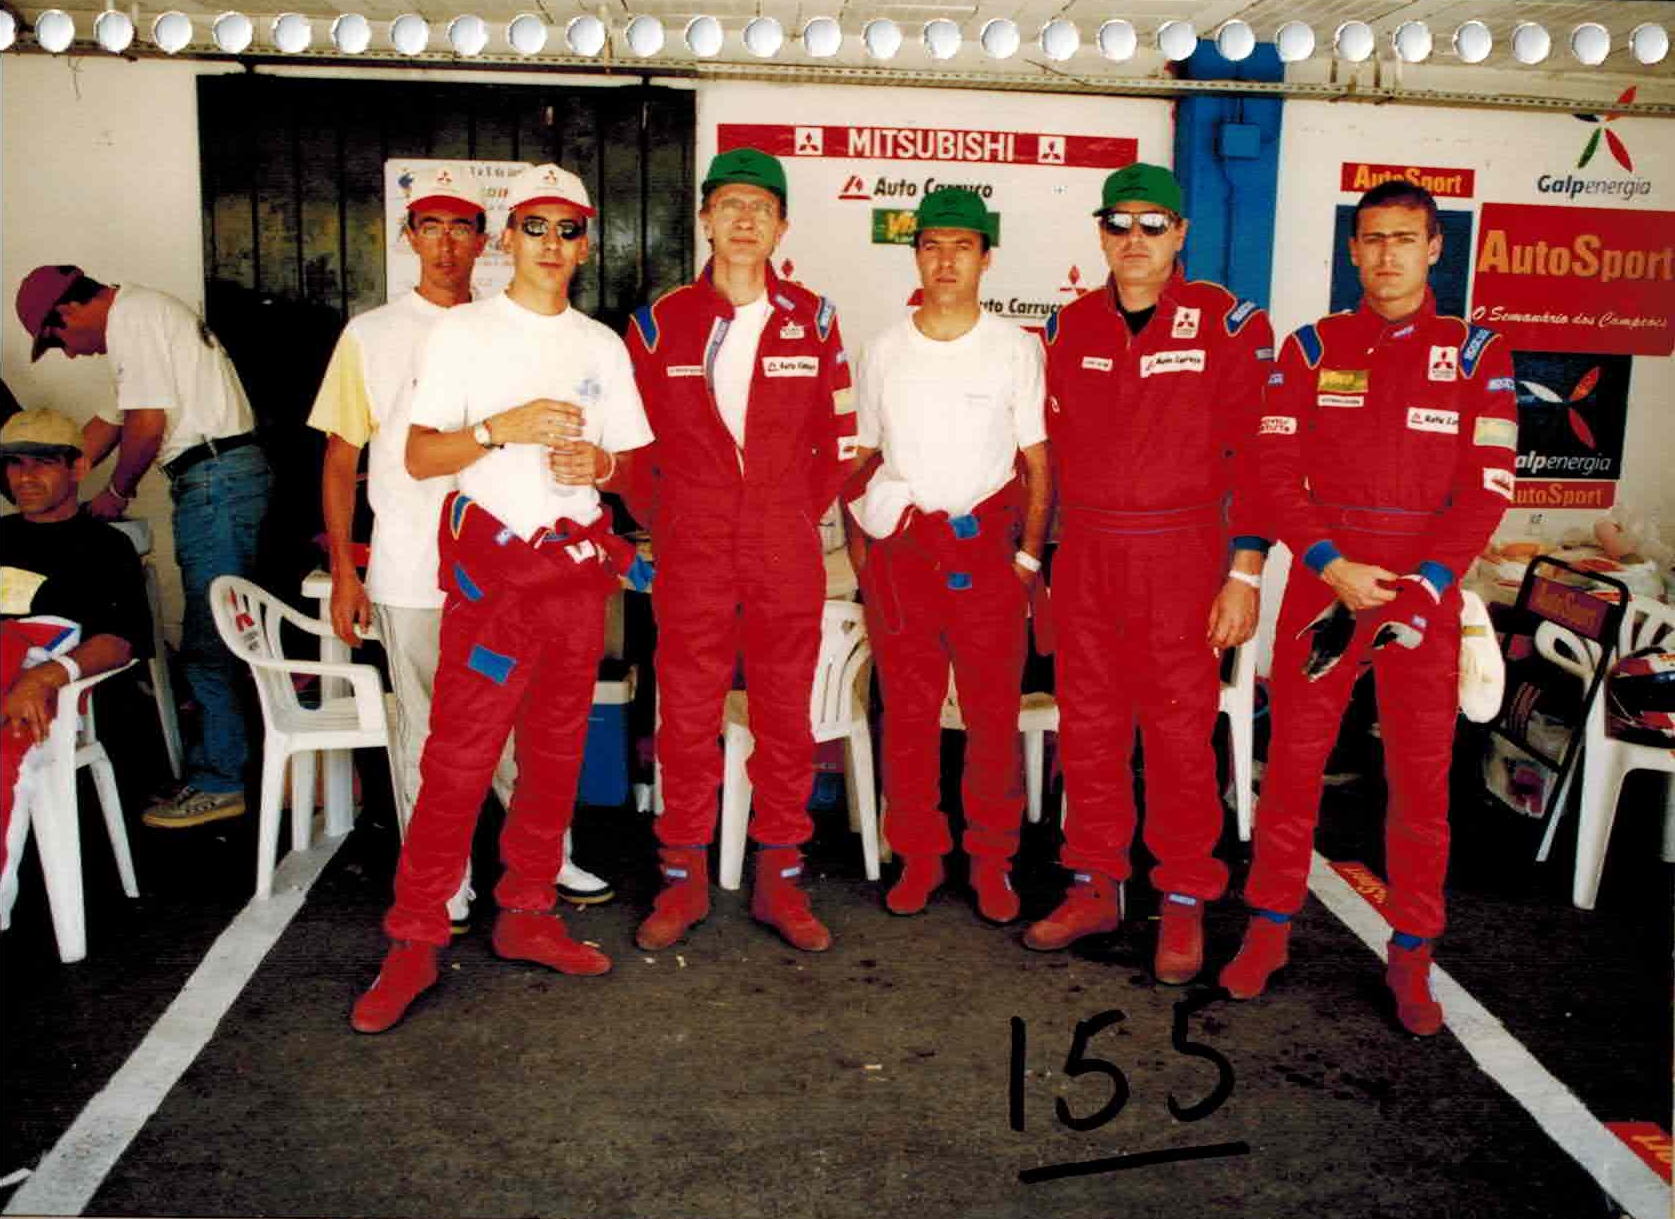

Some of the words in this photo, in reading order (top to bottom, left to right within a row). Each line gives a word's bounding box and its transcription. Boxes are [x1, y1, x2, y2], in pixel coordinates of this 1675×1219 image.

[848, 127, 1016, 162] MITSUBISHI
[874, 177, 917, 197] Auto
[1537, 174, 1652, 201] Galpenergia
[1477, 229, 1675, 283] AutoSport
[979, 298, 1003, 313] uto
[1472, 305, 1486, 321] O
[1572, 312, 1595, 326] dos
[1515, 450, 1612, 476] alpenergia
[1511, 483, 1603, 507] utoSport
[1010, 991, 1235, 1132] 155
